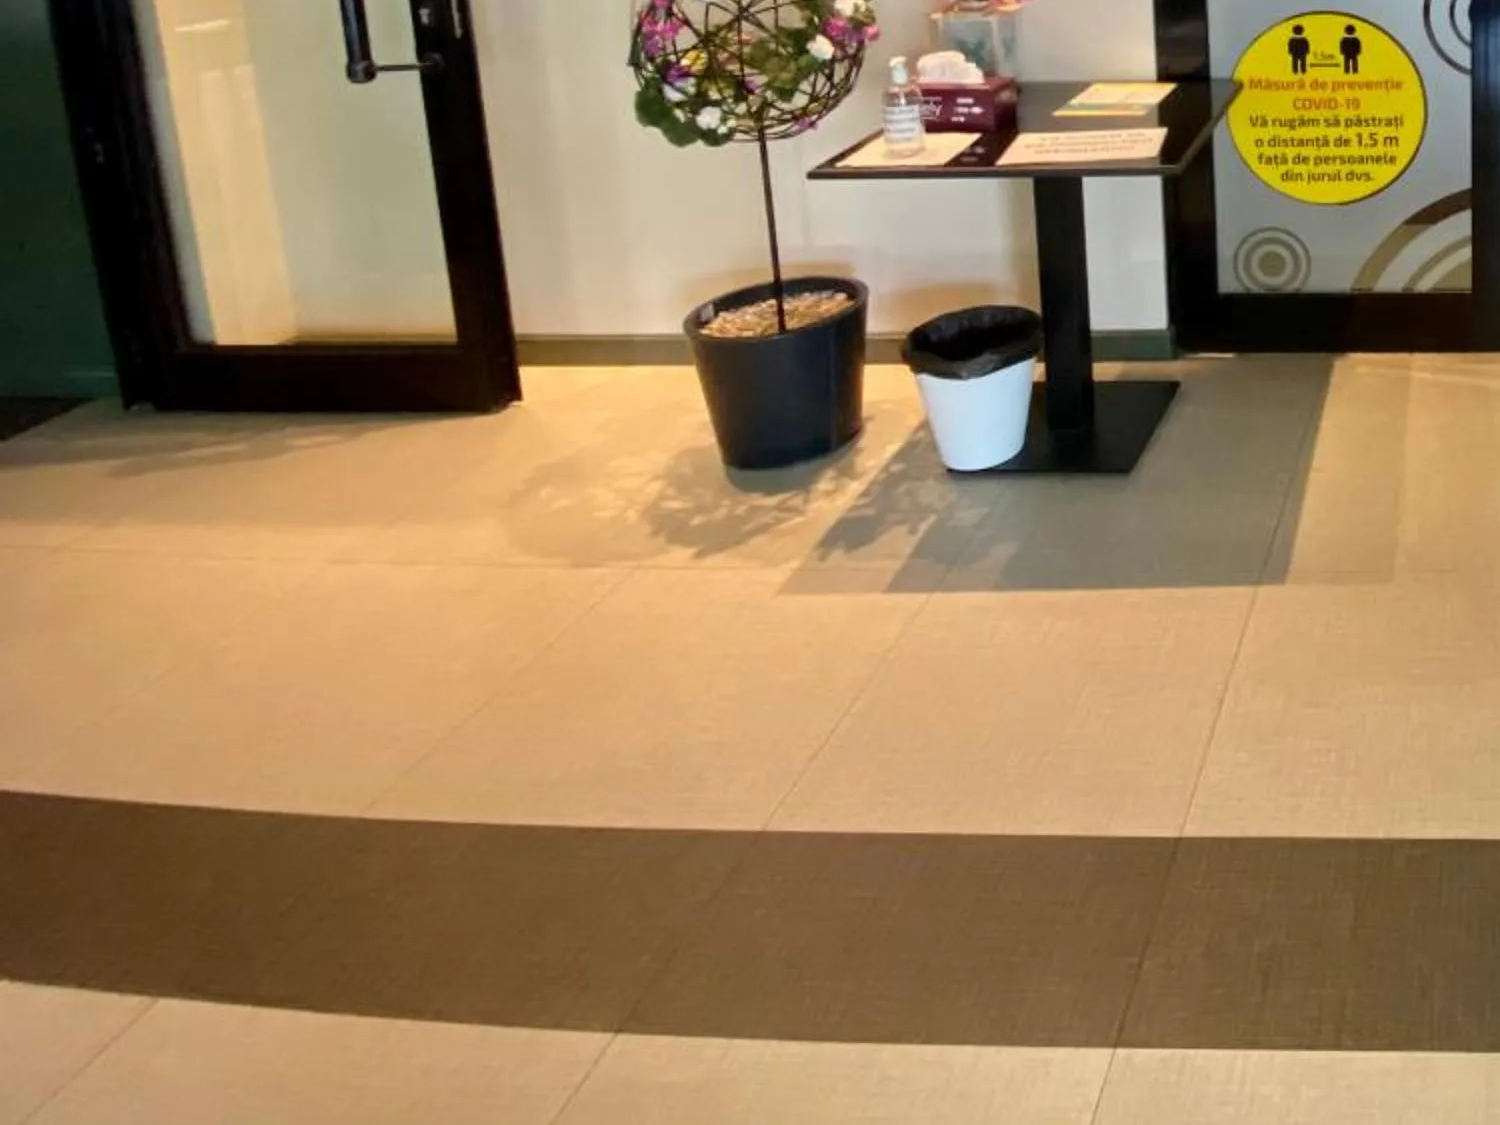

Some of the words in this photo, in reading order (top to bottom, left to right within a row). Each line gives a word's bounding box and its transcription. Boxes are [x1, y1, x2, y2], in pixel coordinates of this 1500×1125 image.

[1310, 78, 1328, 91] de
[1255, 137, 1264, 147] o
[1333, 134, 1352, 147] de
[1383, 136, 1399, 147] m
[1292, 153, 1310, 165] de
[1313, 153, 1397, 167] persoanele
[1280, 170, 1304, 182] din
[1307, 170, 1341, 184] jurul
